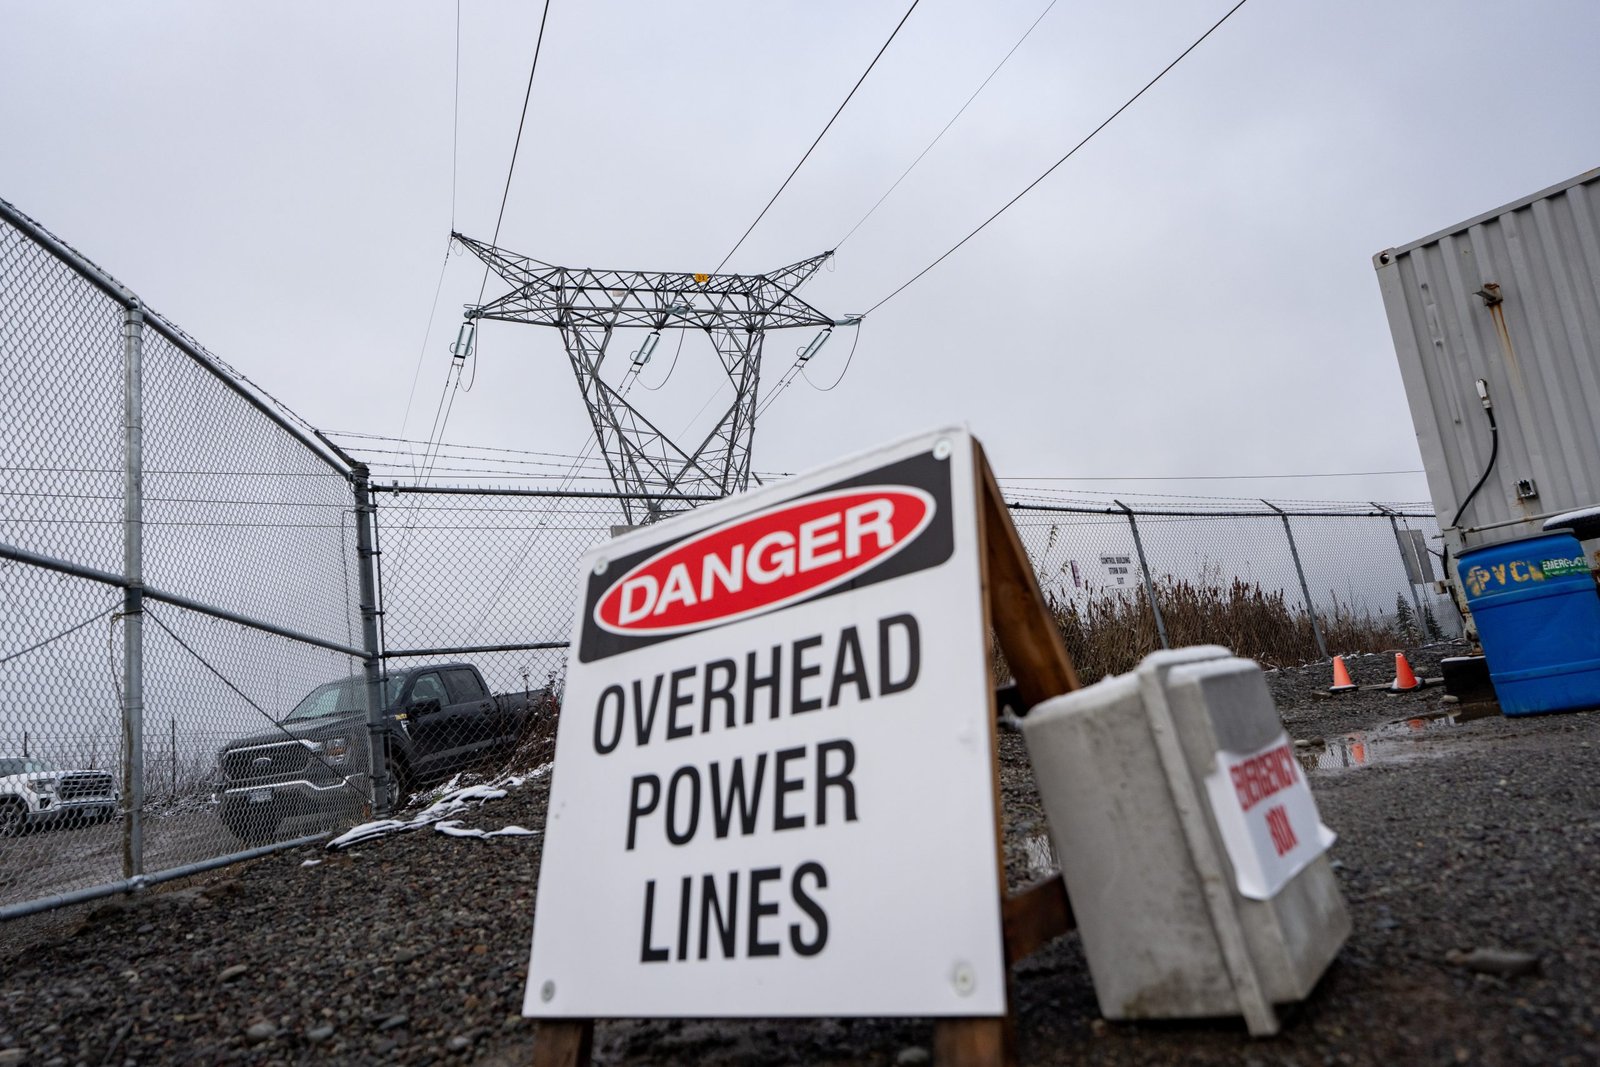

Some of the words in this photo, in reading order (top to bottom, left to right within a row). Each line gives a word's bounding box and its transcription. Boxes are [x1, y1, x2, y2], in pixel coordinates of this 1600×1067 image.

[617, 498, 895, 626] DANGER
[593, 612, 921, 755] OVERHEAD
[625, 739, 859, 851] POWER
[640, 860, 829, 964] LINES
